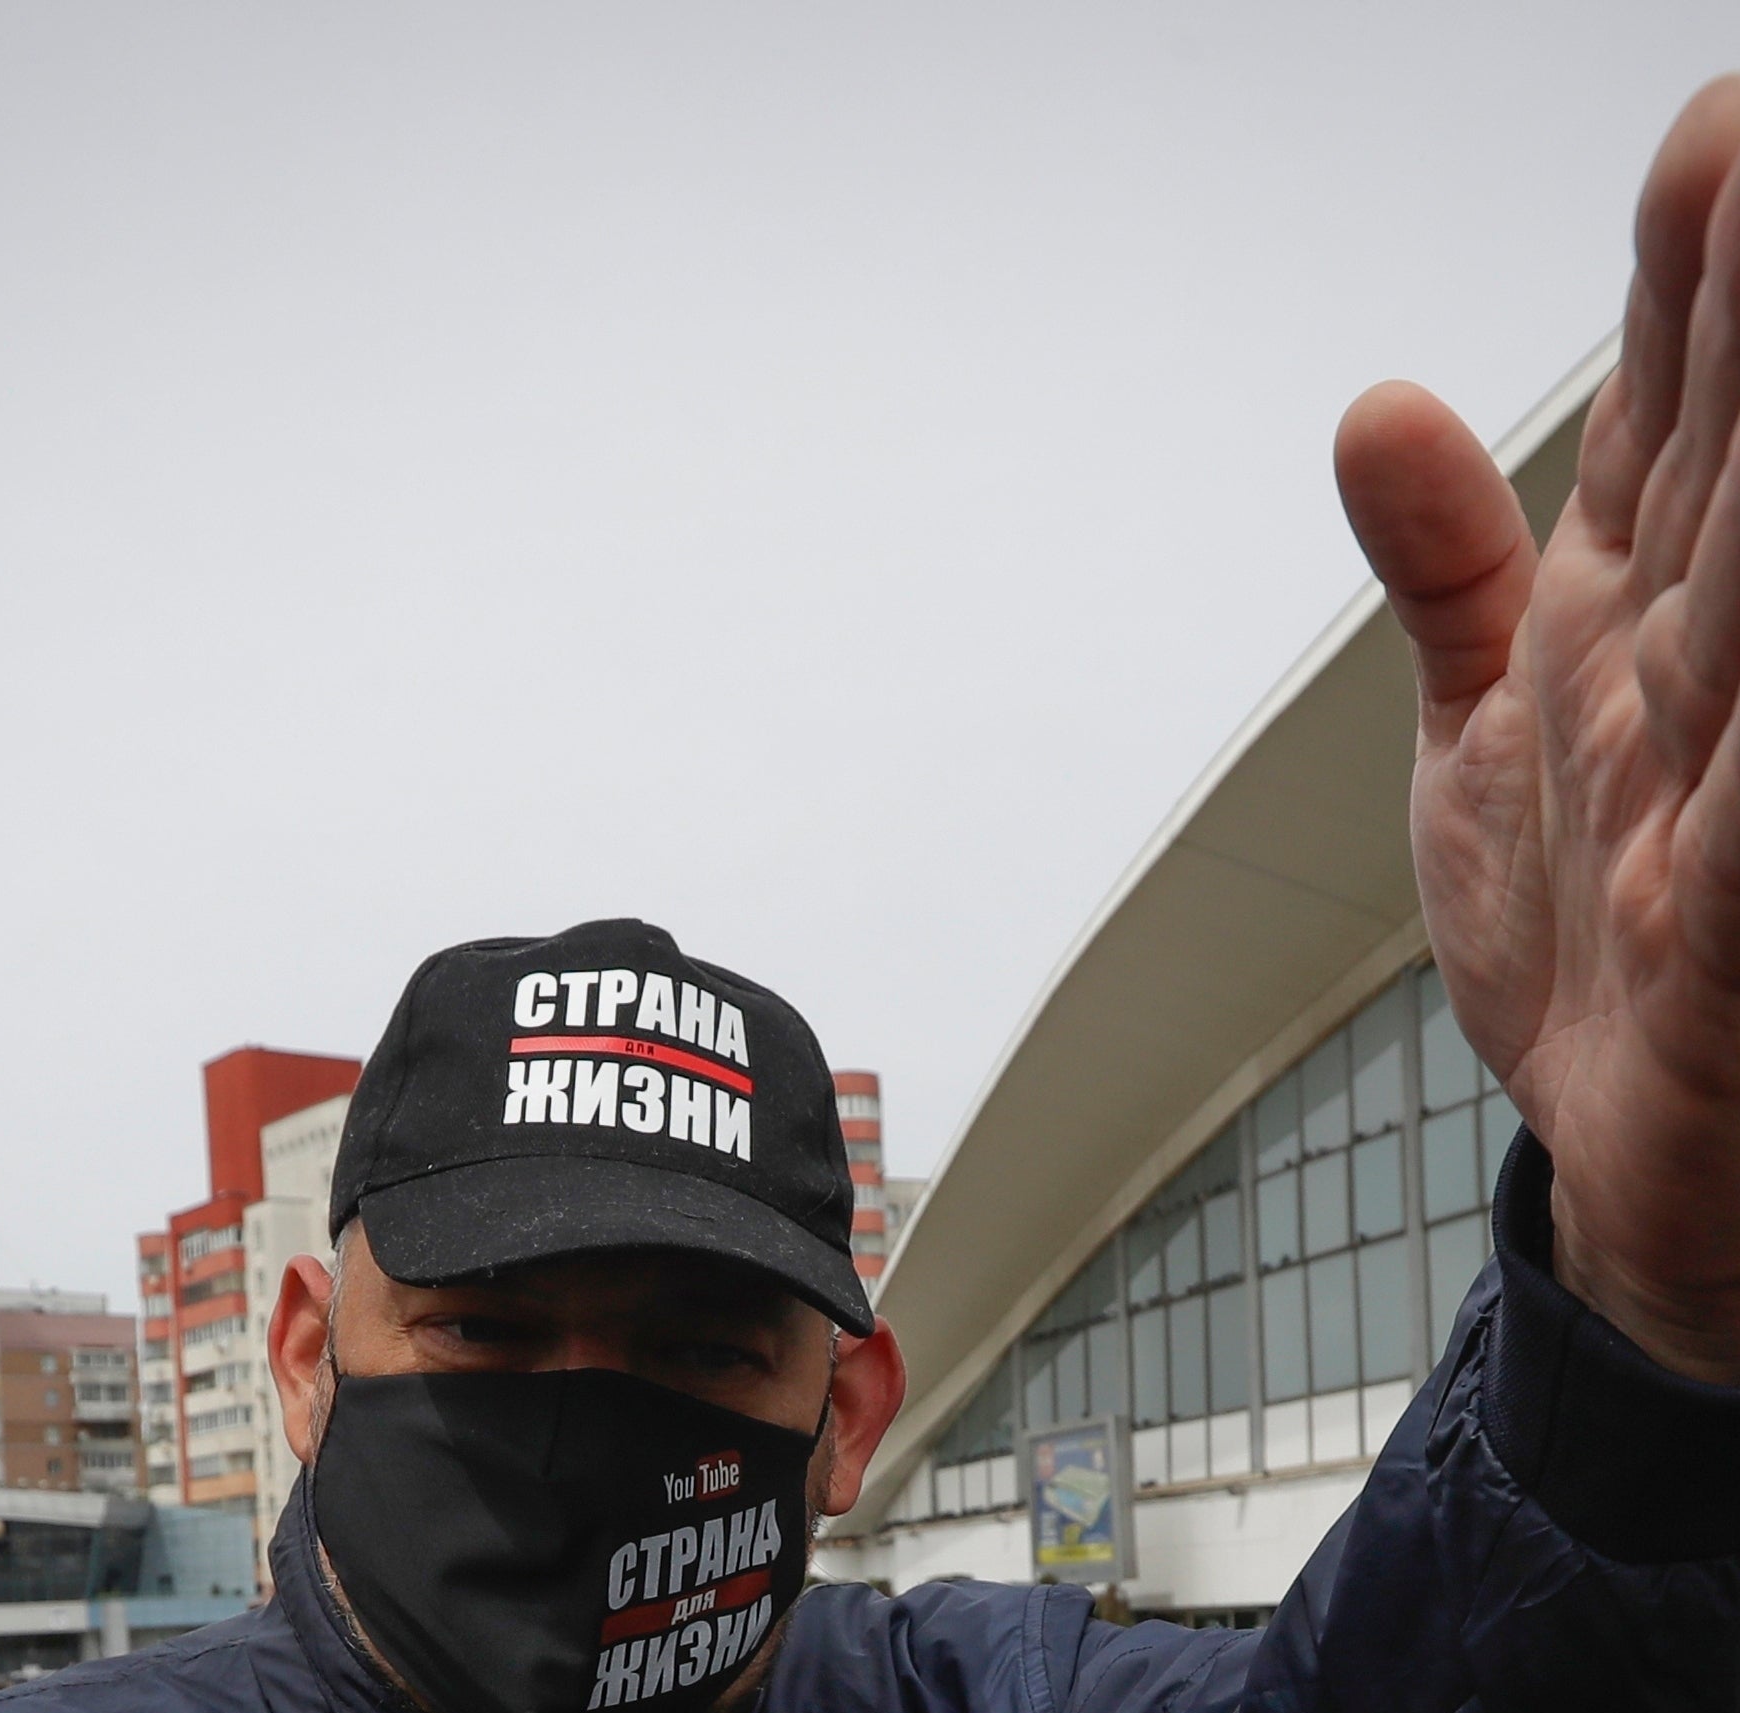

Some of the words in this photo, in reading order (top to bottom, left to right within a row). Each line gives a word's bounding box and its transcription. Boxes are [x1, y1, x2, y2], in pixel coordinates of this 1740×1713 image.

[513, 967, 750, 1068] СТРАНА
[502, 1058, 752, 1163] ЖИЗНИ
[607, 1498, 783, 1611] СТРАНА
[586, 1593, 773, 1711] ЖИЗНИ
